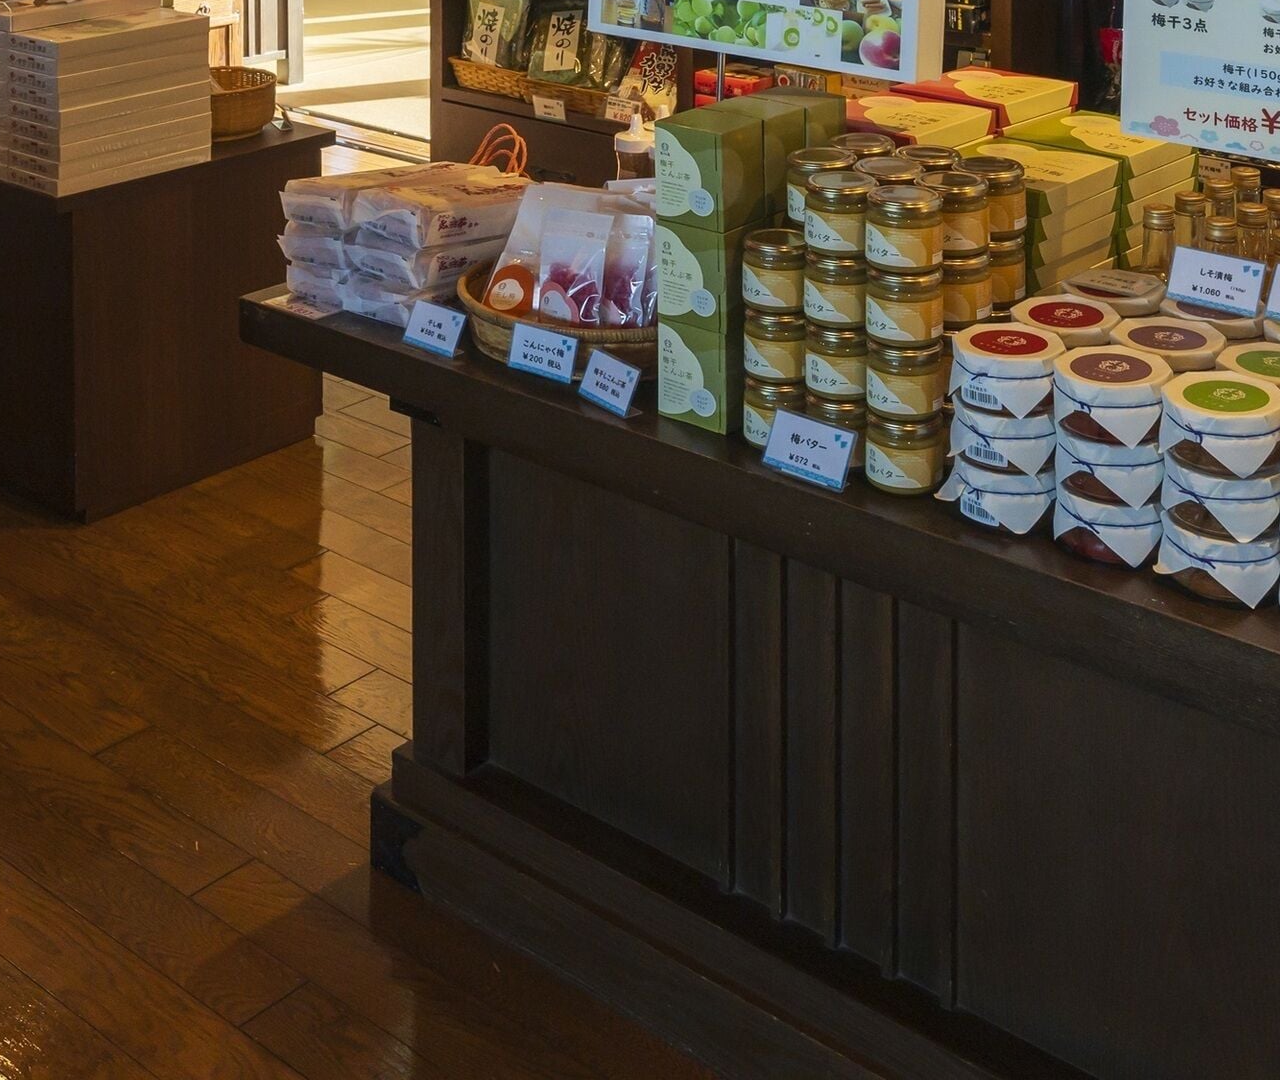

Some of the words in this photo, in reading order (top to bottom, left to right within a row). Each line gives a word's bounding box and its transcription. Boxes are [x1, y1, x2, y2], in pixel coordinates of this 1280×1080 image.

[1151, 12, 1209, 34] 梅干3点
[552, 16, 577, 67] 焼のり
[1200, 266, 1233, 283] しそ漬梅
[523, 338, 566, 358] こんにゃく梅
[522, 351, 543, 365] ¥200
[547, 358, 562, 371] 税込
[790, 431, 828, 451] 梅バター
[788, 453, 809, 466] ¥572
